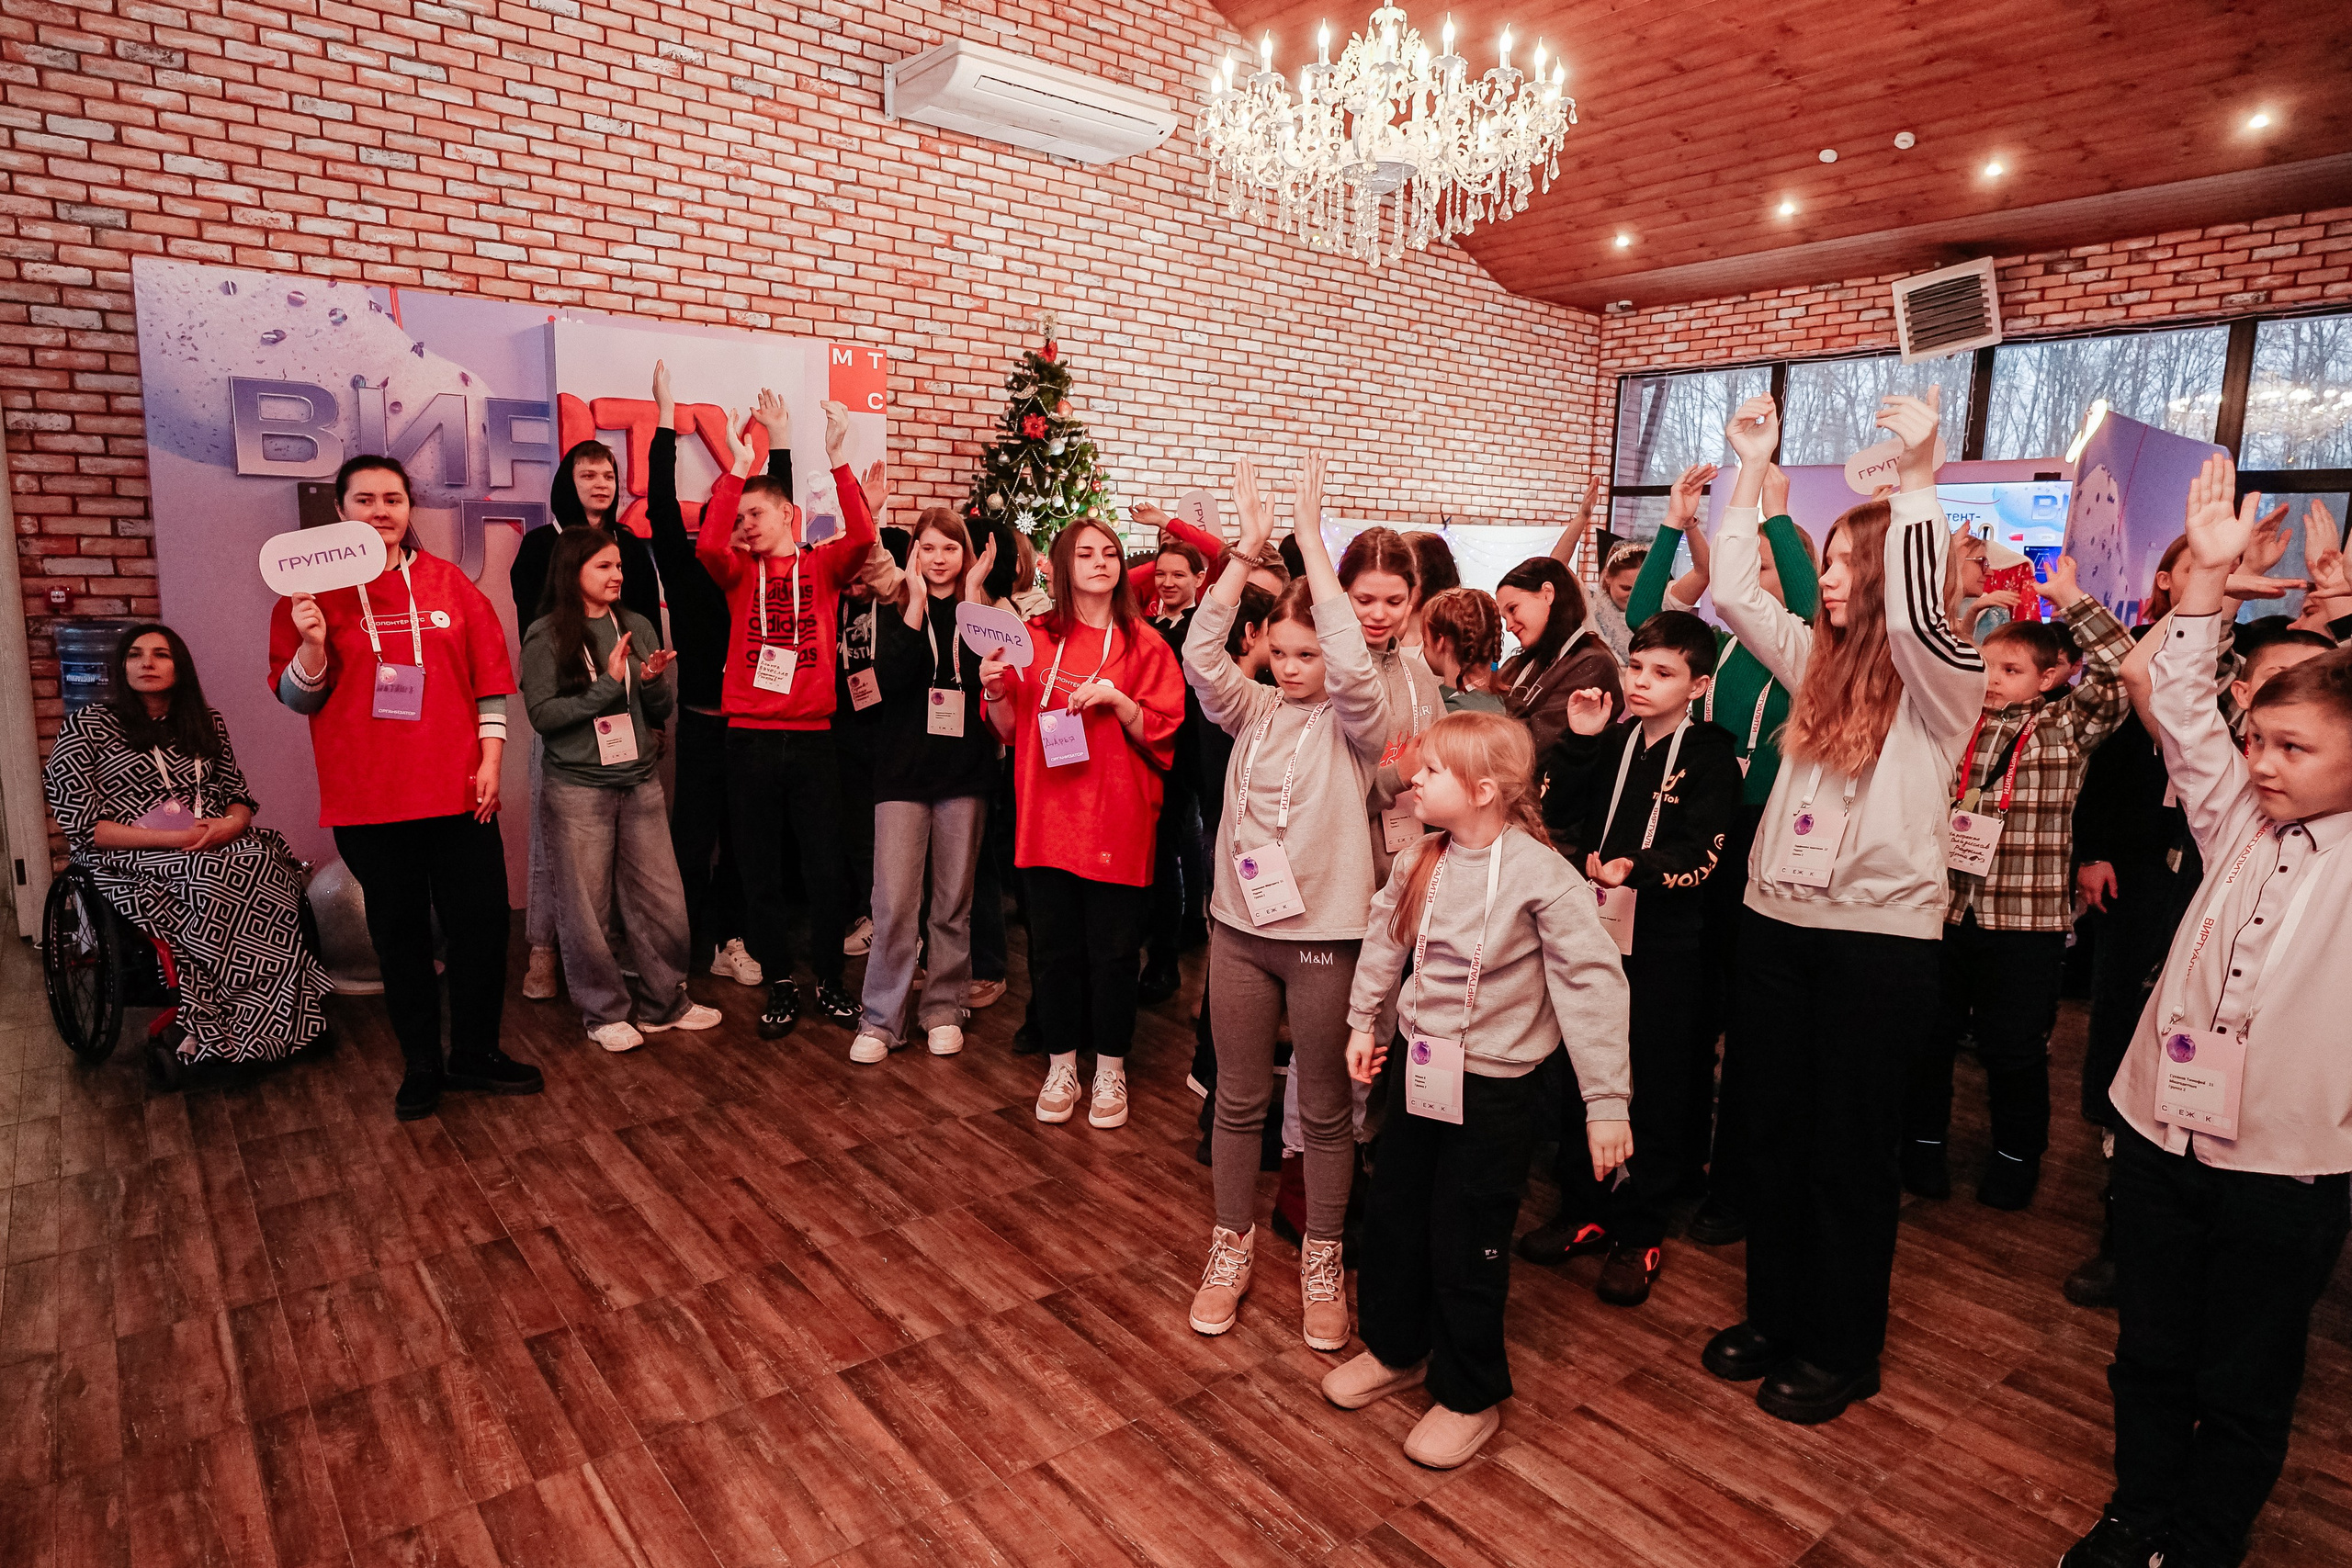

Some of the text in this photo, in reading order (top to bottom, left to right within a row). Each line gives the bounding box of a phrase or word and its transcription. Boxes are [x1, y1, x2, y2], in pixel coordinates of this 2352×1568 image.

[1858, 456, 1900, 479] ГРУП
[277, 544, 367, 572] ГРУППА 1
[749, 614, 817, 633] adidas
[966, 623, 1023, 648] ГРУППА 2
[746, 647, 817, 663] aas
[1306, 701, 1327, 730] АЛИТИ
[1237, 767, 1250, 825] ВИРТУАЛИТИ
[1652, 792, 1679, 804] TiTok
[1428, 845, 1450, 903] ИРТУАЛИТИ
[1299, 950, 1334, 965] M&M
[1465, 943, 1483, 1008] ВИРТУАЛИТИ
